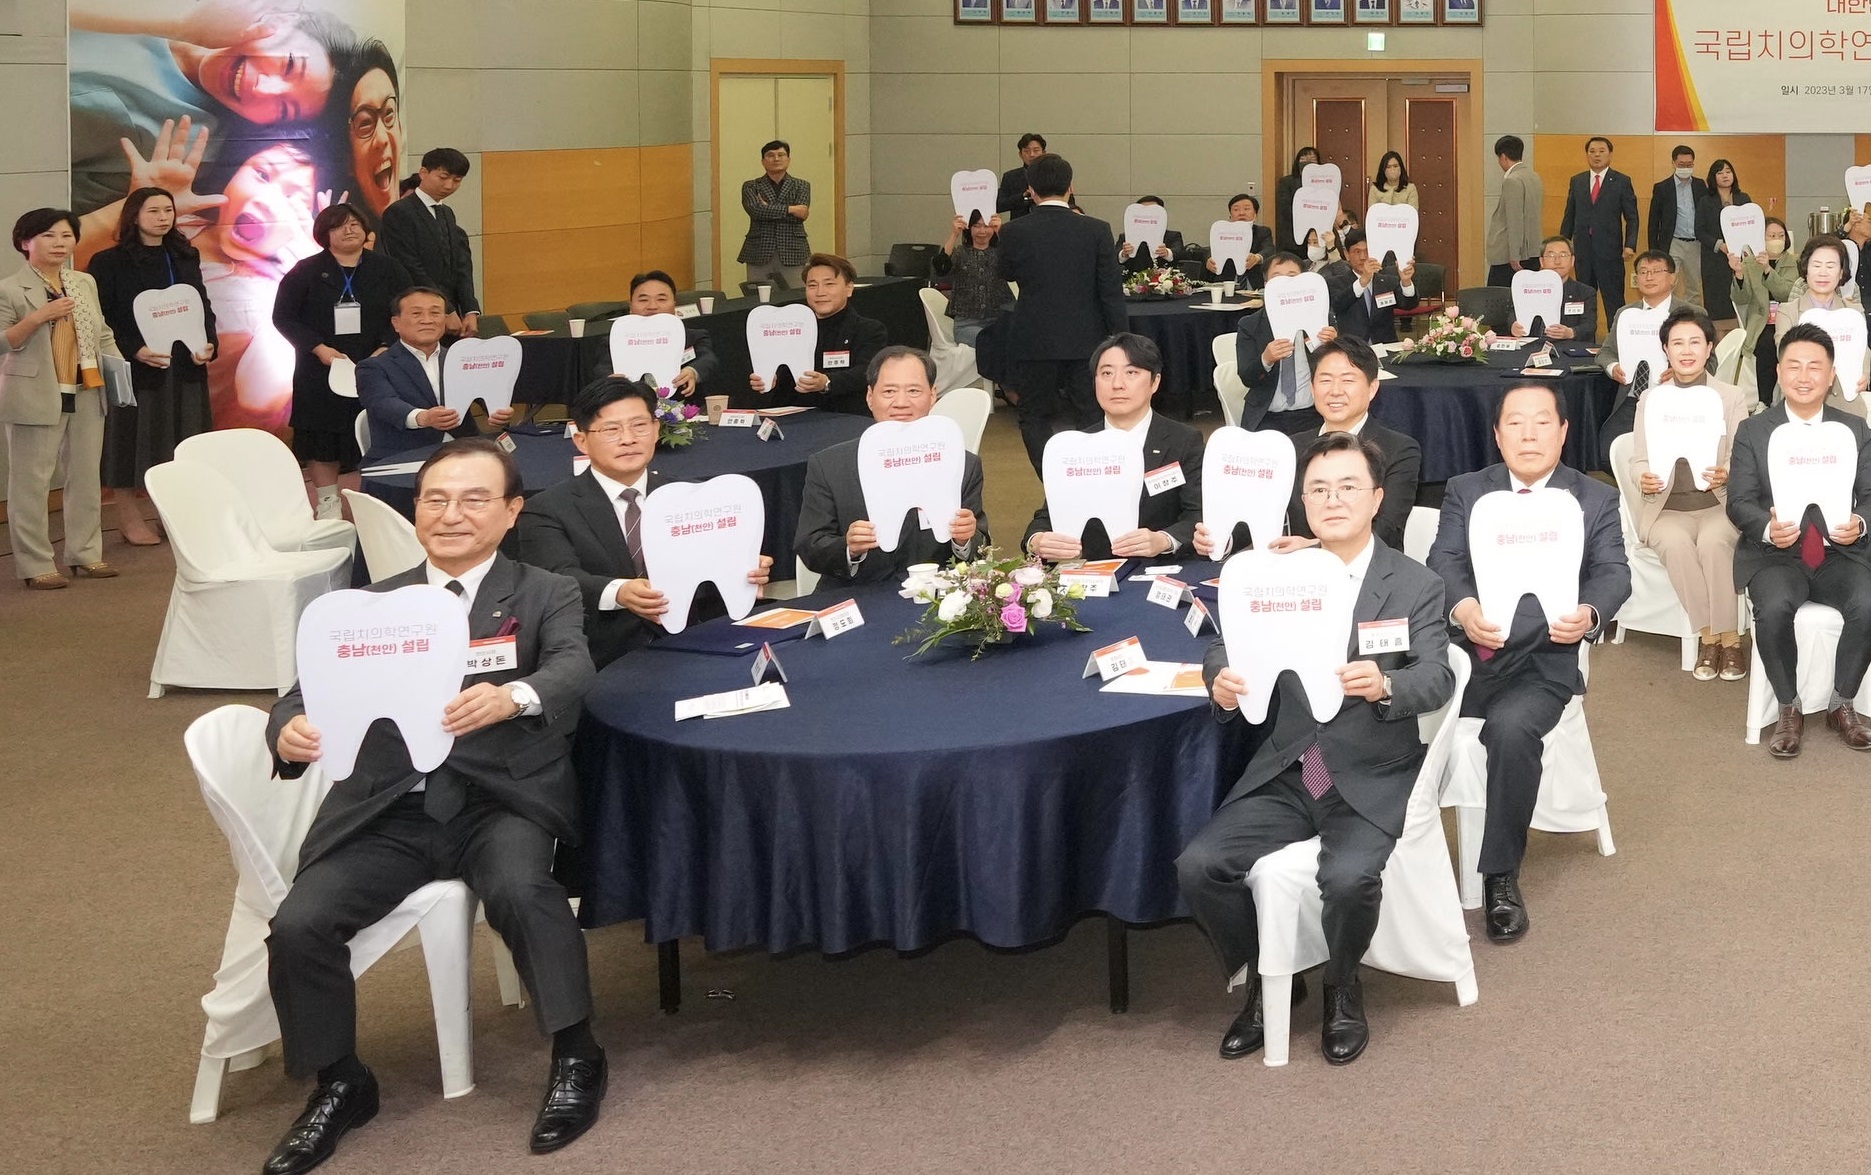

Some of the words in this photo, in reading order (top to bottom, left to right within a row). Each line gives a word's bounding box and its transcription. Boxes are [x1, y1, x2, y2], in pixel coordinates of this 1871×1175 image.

[1781, 85, 1798, 96] 일시
[1804, 85, 1836, 95] 2023년
[1839, 85, 1854, 96] 3월
[883, 456, 921, 469] 충남(천안)
[923, 451, 942, 464] 설립
[1066, 467, 1102, 477] 충남(천안)
[1104, 465, 1121, 475] 설립
[1257, 468, 1274, 480] 설립
[670, 521, 713, 538] 충남(천안)
[716, 515, 738, 530] 설립
[1242, 583, 1328, 598] 국립치의학연구원
[1249, 600, 1297, 613] 충남(천안)
[1300, 598, 1323, 612] 설립
[329, 622, 439, 642] 국립치의학연구원
[336, 640, 397, 659] 충남(천안)
[400, 637, 430, 654] 설립
[466, 655, 507, 668] 박상돈
